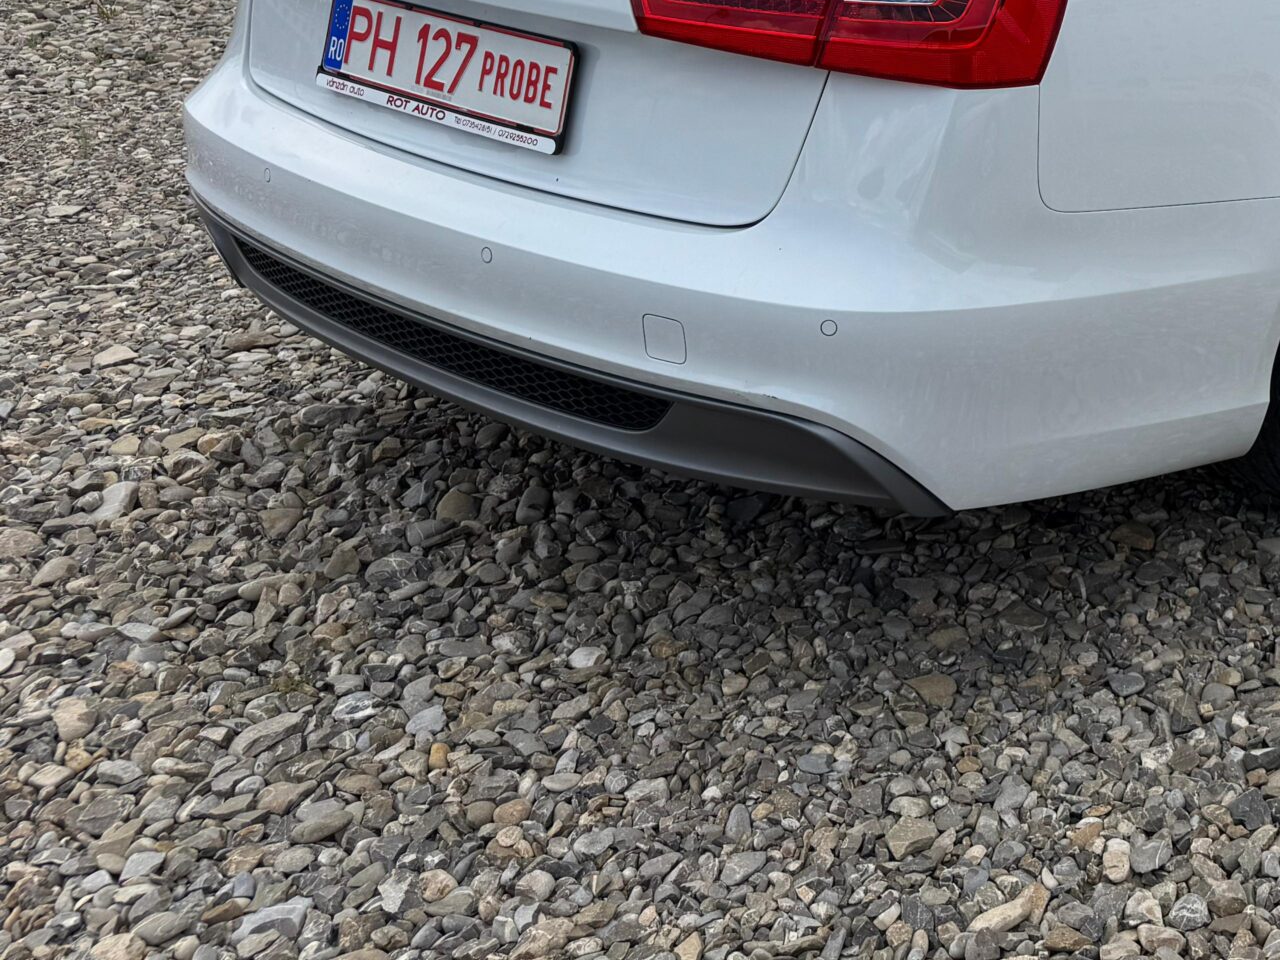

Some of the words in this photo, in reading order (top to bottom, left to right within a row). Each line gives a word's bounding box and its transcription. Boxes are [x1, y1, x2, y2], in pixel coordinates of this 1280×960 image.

[328, 36, 344, 62] RO
[343, 5, 402, 77] PH
[414, 23, 479, 94] 127
[478, 50, 558, 109] PROBE
[386, 95, 411, 110] ROT
[412, 103, 446, 121] AUTO
